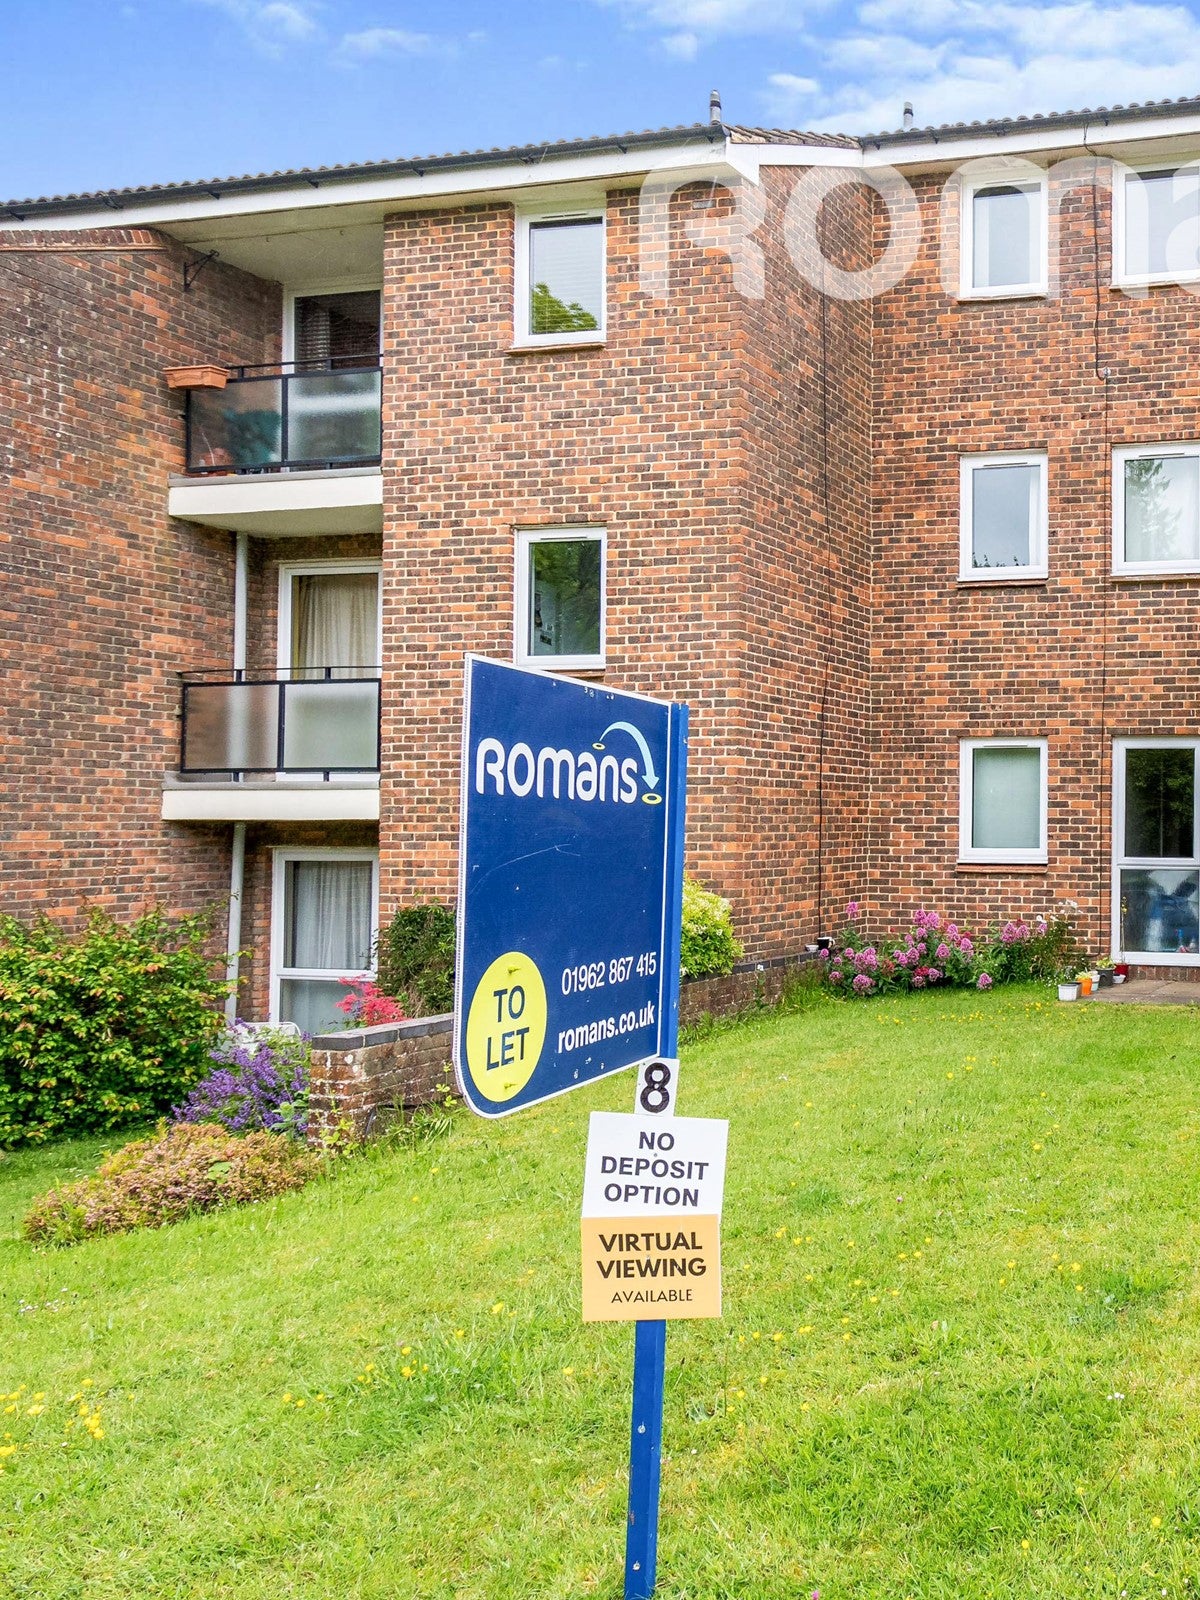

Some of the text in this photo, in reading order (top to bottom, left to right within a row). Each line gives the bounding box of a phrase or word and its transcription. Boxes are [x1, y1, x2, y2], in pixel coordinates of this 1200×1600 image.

[562, 952, 656, 995] 01962 867 415
[493, 985, 525, 1022] TO
[558, 1001, 654, 1053] romans.co.uk
[486, 1027, 530, 1070] LET
[640, 1062, 671, 1113] 8
[638, 1131, 675, 1151] NO
[600, 1156, 709, 1180] DEPOSIT
[604, 1183, 699, 1207] OPTION
[598, 1231, 703, 1252] VIRTUAL
[596, 1257, 707, 1279] VIEWING
[611, 1289, 693, 1303] AVAILABLE
